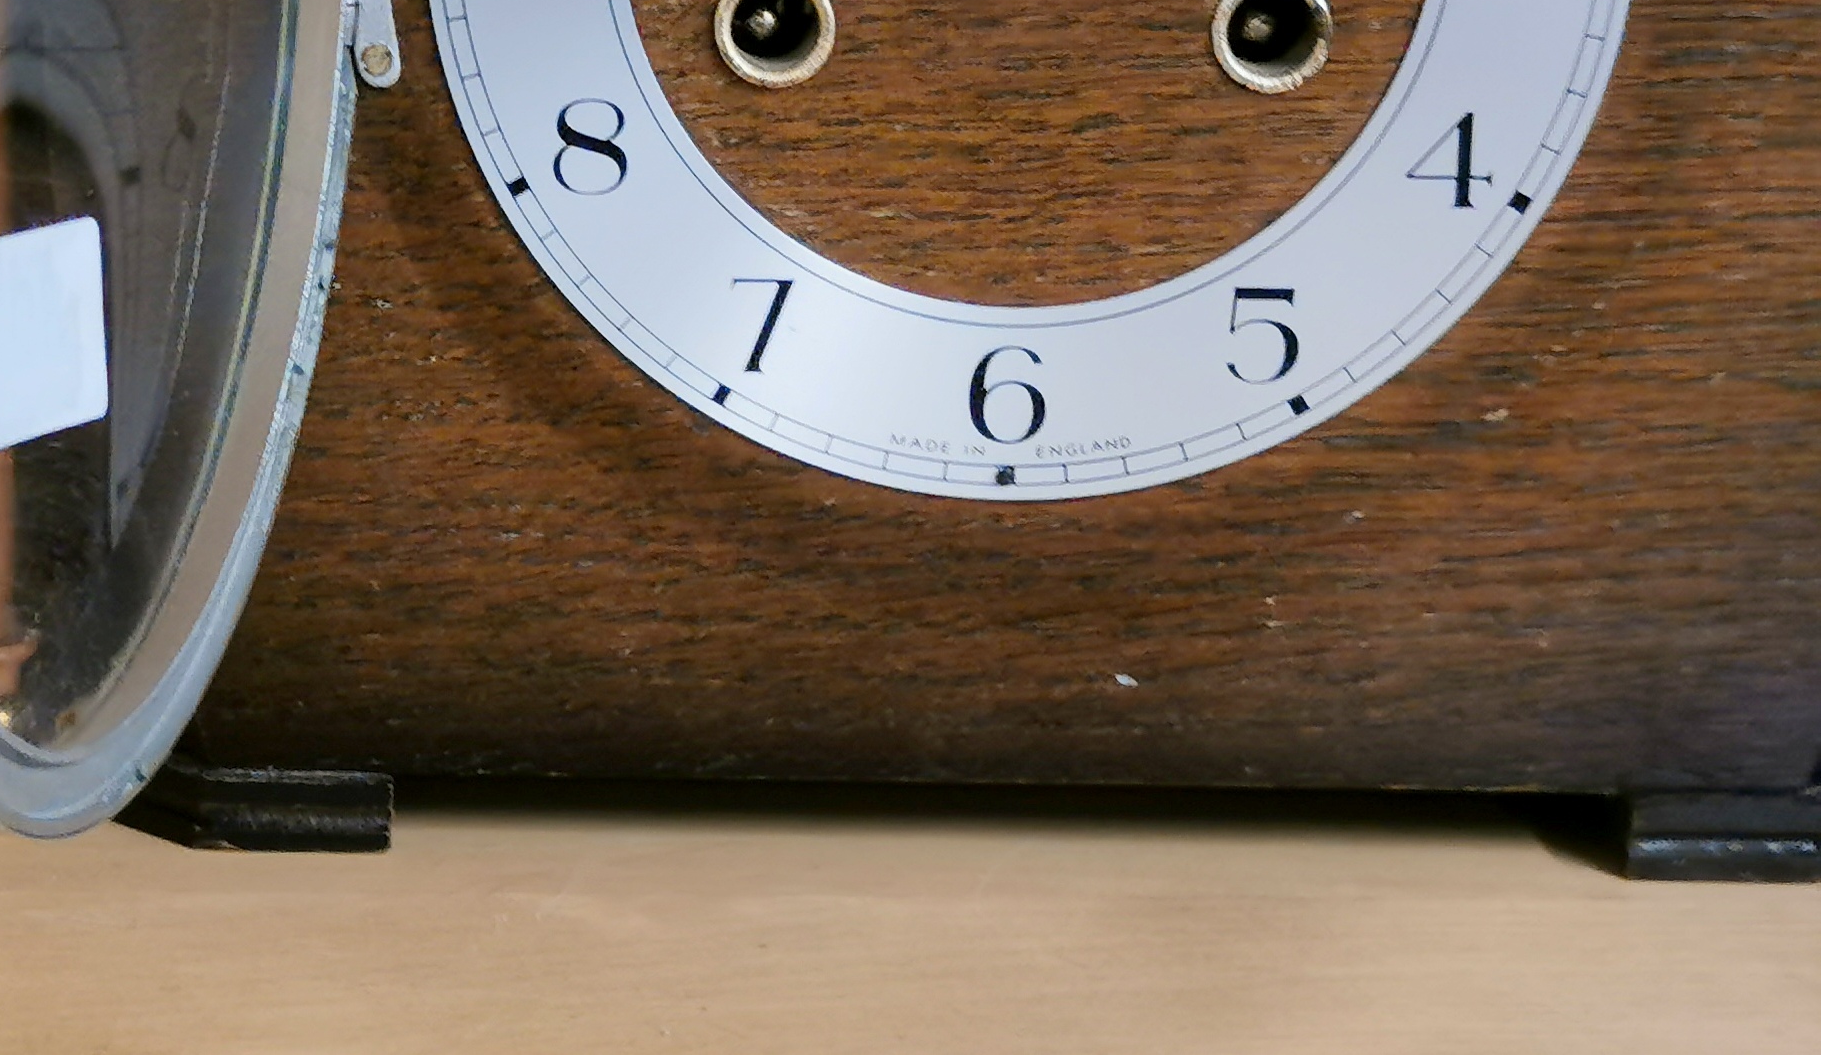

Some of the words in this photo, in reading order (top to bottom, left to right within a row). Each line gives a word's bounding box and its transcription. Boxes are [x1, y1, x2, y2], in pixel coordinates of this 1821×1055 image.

[553, 98, 627, 194] 8
[1406, 113, 1492, 208] 4
[731, 280, 792, 373] 7
[1226, 289, 1298, 385] 5
[969, 347, 1045, 443] 6
[889, 432, 951, 455] MADE
[963, 445, 986, 456] IN
[1035, 435, 1132, 458] ENGLAND
